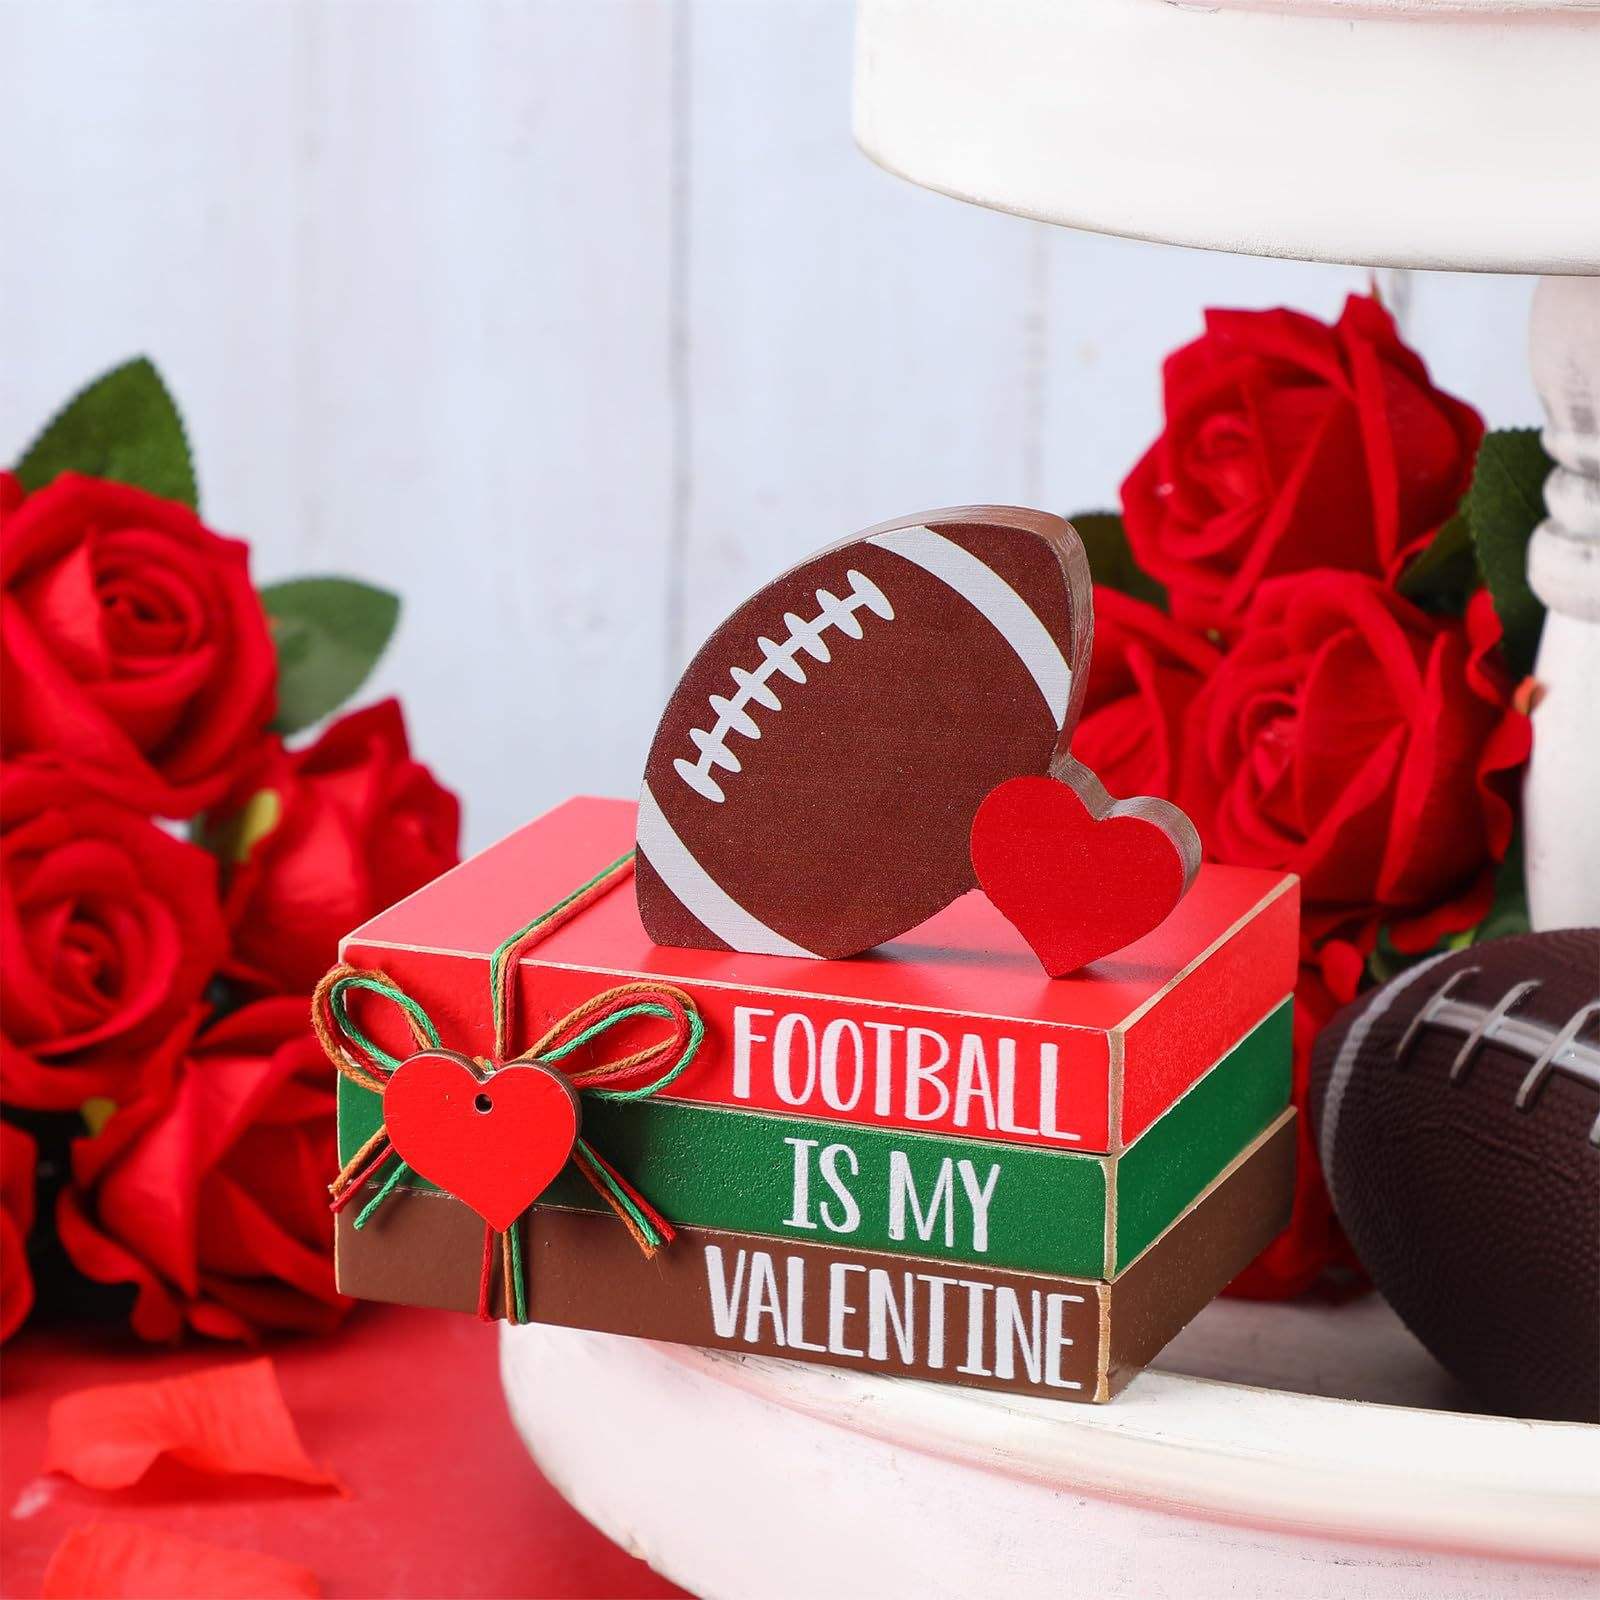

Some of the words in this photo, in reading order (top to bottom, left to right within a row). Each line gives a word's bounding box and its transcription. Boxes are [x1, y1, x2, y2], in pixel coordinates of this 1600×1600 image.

[733, 1006, 1081, 1141] FOOTBALL
[783, 1137, 861, 1234] IS
[888, 1151, 1001, 1253] MY
[705, 1245, 1085, 1390] VALENTINE
